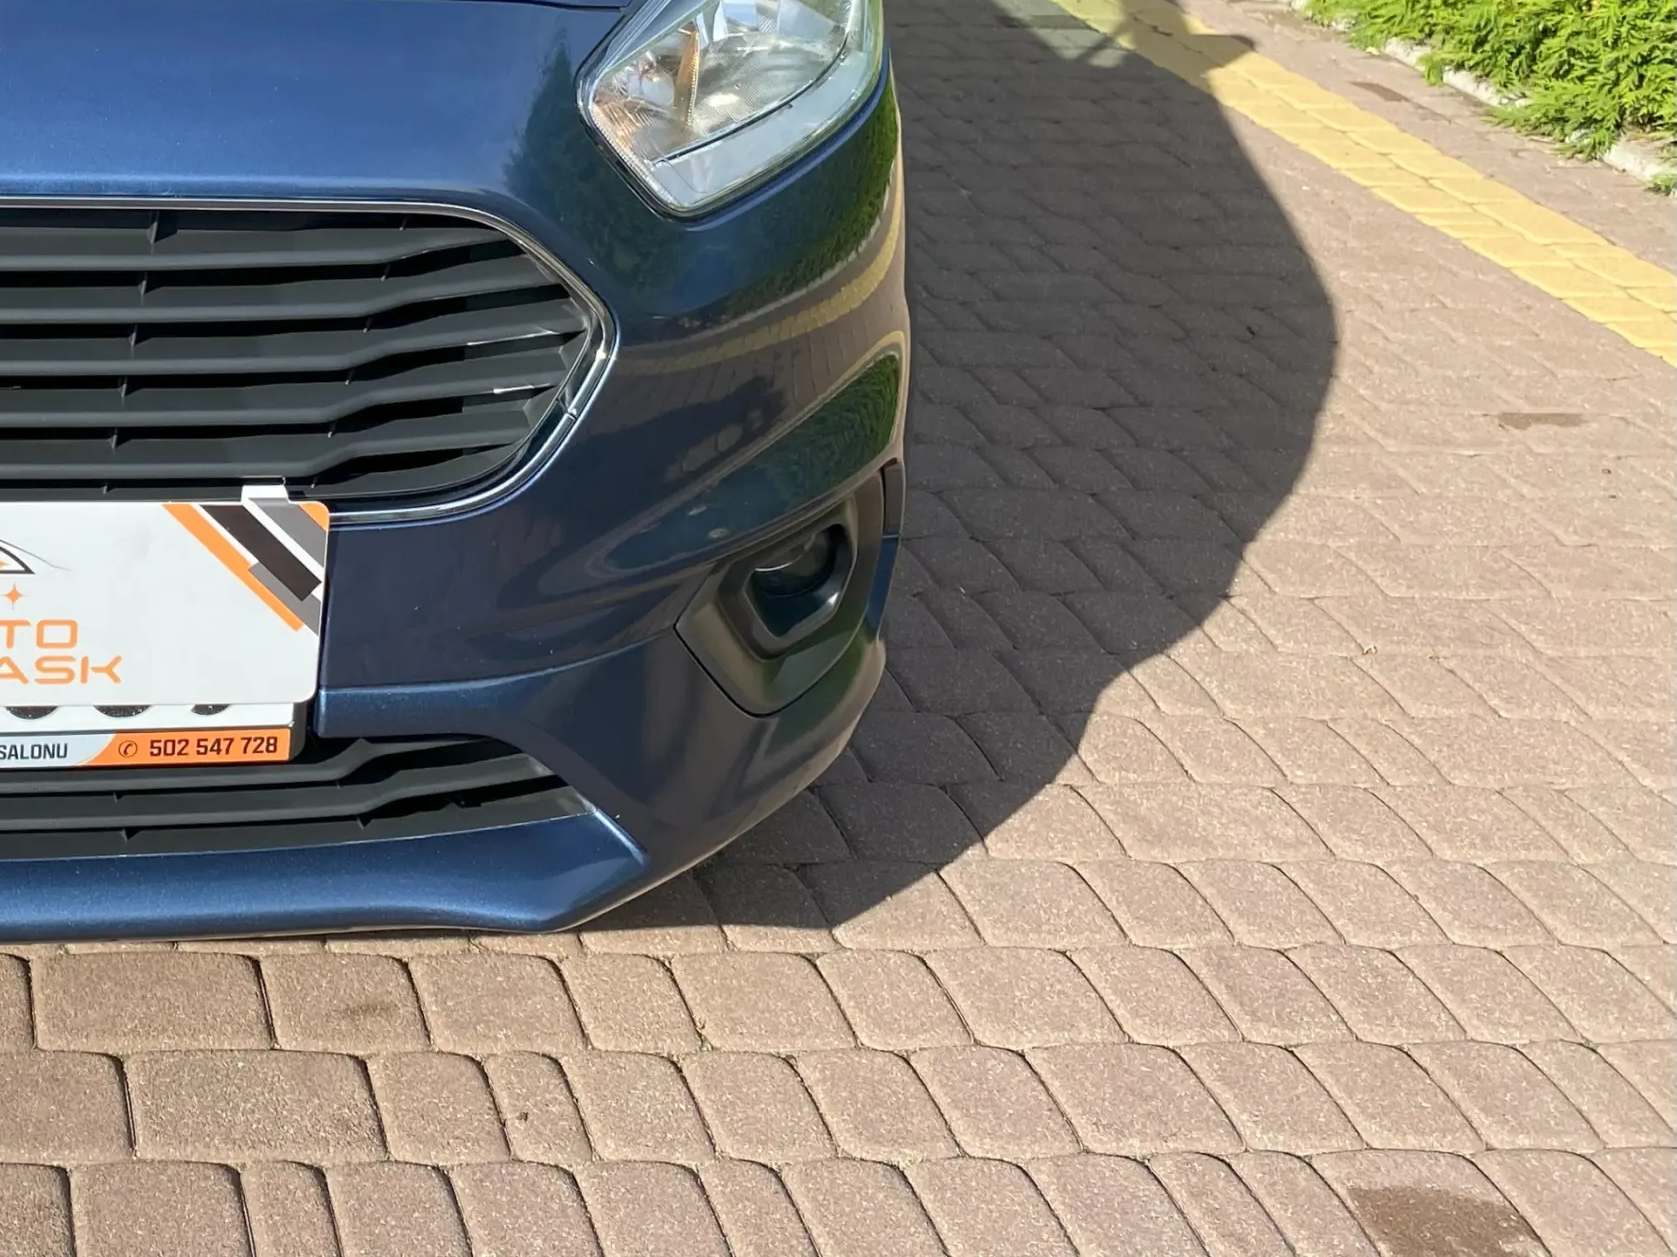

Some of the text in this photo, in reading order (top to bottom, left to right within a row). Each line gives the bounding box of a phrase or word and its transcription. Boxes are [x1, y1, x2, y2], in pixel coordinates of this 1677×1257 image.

[149, 736, 278, 757] 502 547 728
